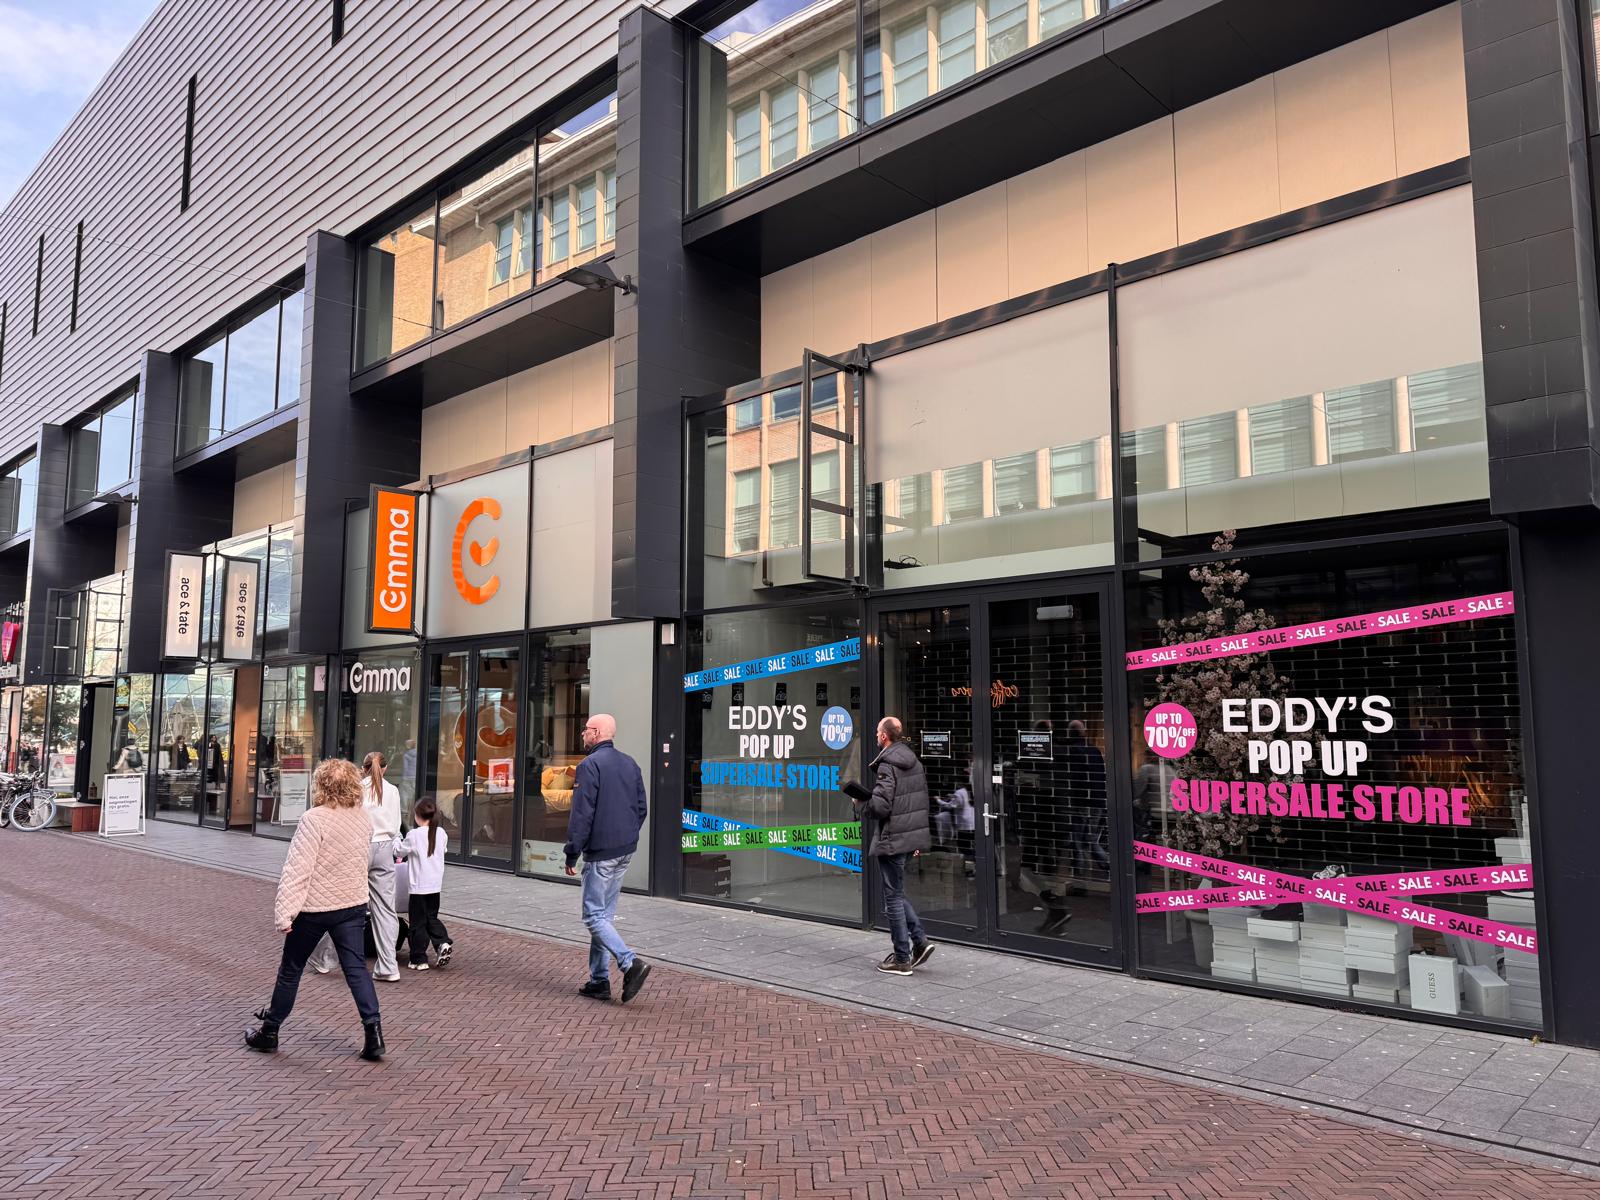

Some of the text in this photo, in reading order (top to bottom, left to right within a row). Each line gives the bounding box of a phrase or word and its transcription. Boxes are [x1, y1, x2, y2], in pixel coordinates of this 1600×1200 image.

[178, 577, 190, 634] ace & tate
[1126, 597, 1504, 665] ALE SALE SALE SALE SALE SALE SALE SALE SALE SALE
[350, 662, 411, 693] Emma
[683, 643, 860, 688] SALE SALE SALE SALE SALE SALE SALE SALE
[728, 704, 807, 730] EDDY'S
[828, 714, 845, 724] UP TO
[1155, 713, 1182, 725] UP TO
[1222, 695, 1394, 734] EDDY'S
[739, 734, 794, 759] POP UP
[821, 724, 846, 742] 70%
[1145, 726, 1187, 748] 70%
[1182, 728, 1195, 737] OFF
[1248, 740, 1368, 776] POP UP
[701, 761, 840, 791] SUPERSALE STORE
[1170, 778, 1472, 826] SUPERSALE STORE
[682, 836, 698, 848] SALE
[702, 834, 719, 847] SALE
[723, 833, 741, 846] SALE
[745, 832, 763, 845] SALE
[768, 830, 787, 844] SALE
[792, 829, 811, 842] SALE
[817, 828, 837, 841] SALE
[682, 812, 698, 826] SALE
[702, 817, 719, 831] SALE
[817, 845, 837, 861] SALE
[843, 851, 864, 867] SALE
[1133, 845, 1535, 949] SALE SALE SALE SALE SALE SALE SALE SALE SALE SALE
[1136, 869, 1529, 909] SALE SALE SALE SALE SALE SALE SALE SALE
[1428, 971, 1437, 999] GUESS
